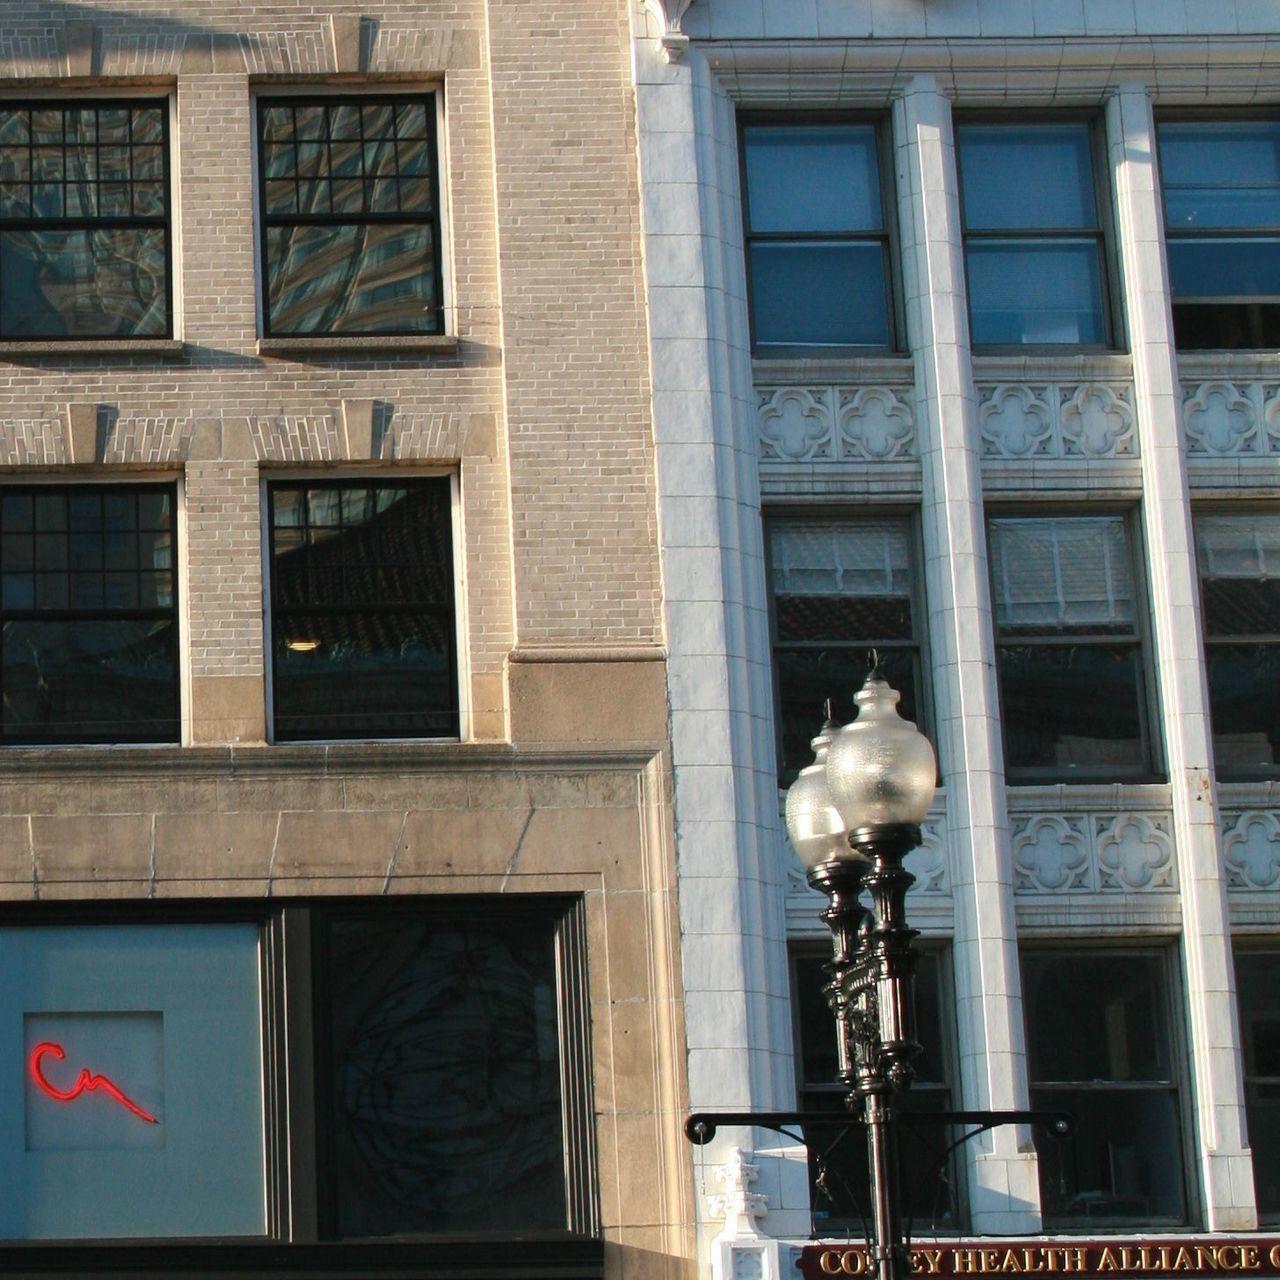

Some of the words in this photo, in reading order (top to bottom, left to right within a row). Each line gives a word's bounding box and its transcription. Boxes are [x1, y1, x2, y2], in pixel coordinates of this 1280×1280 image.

[820, 1249, 945, 1274] COEY
[951, 1247, 1089, 1274] HEALTH
[1096, 1245, 1261, 1272] ALLIANCE
